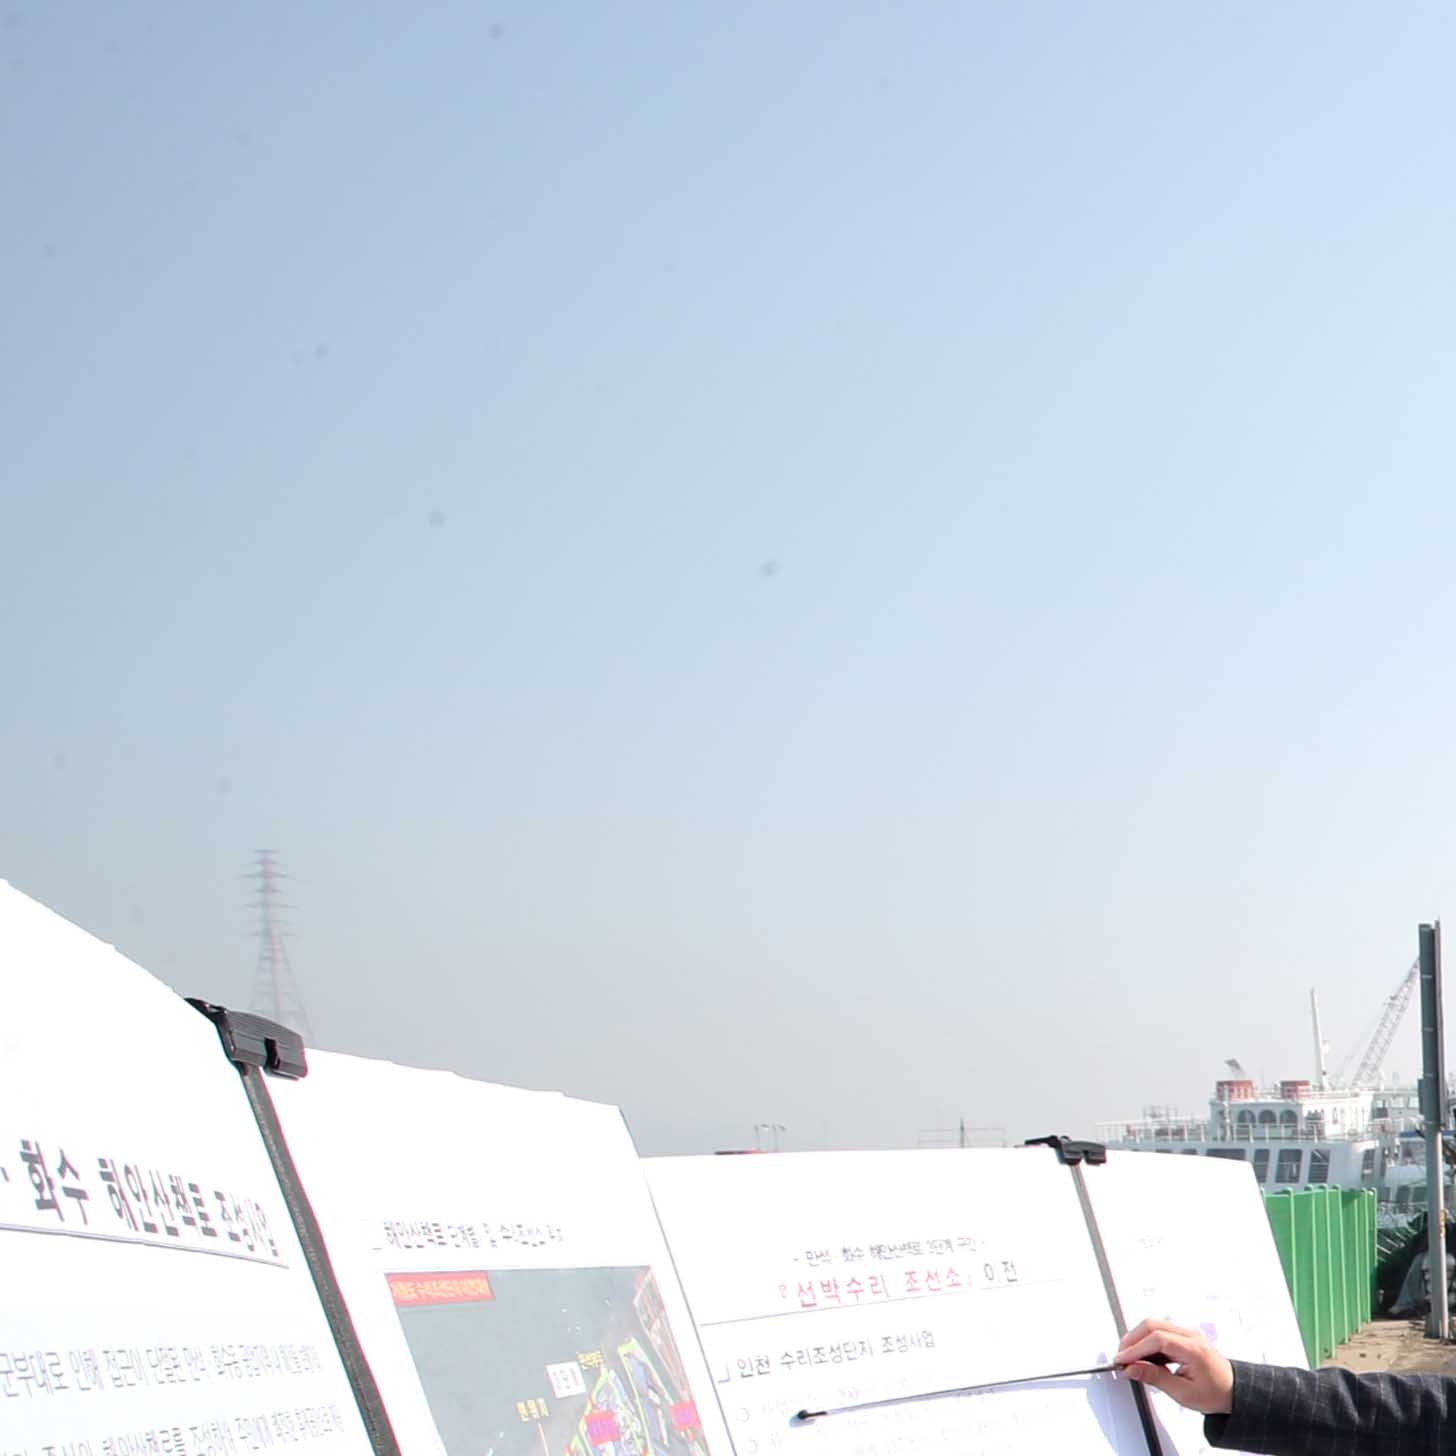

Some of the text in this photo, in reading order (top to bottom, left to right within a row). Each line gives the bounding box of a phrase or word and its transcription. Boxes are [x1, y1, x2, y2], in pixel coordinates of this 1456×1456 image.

[19, 1138, 91, 1226] 화수
[96, 1156, 219, 1239] 해안산책로
[983, 1259, 1019, 1284] 이전
[736, 1355, 772, 1381] 인천
